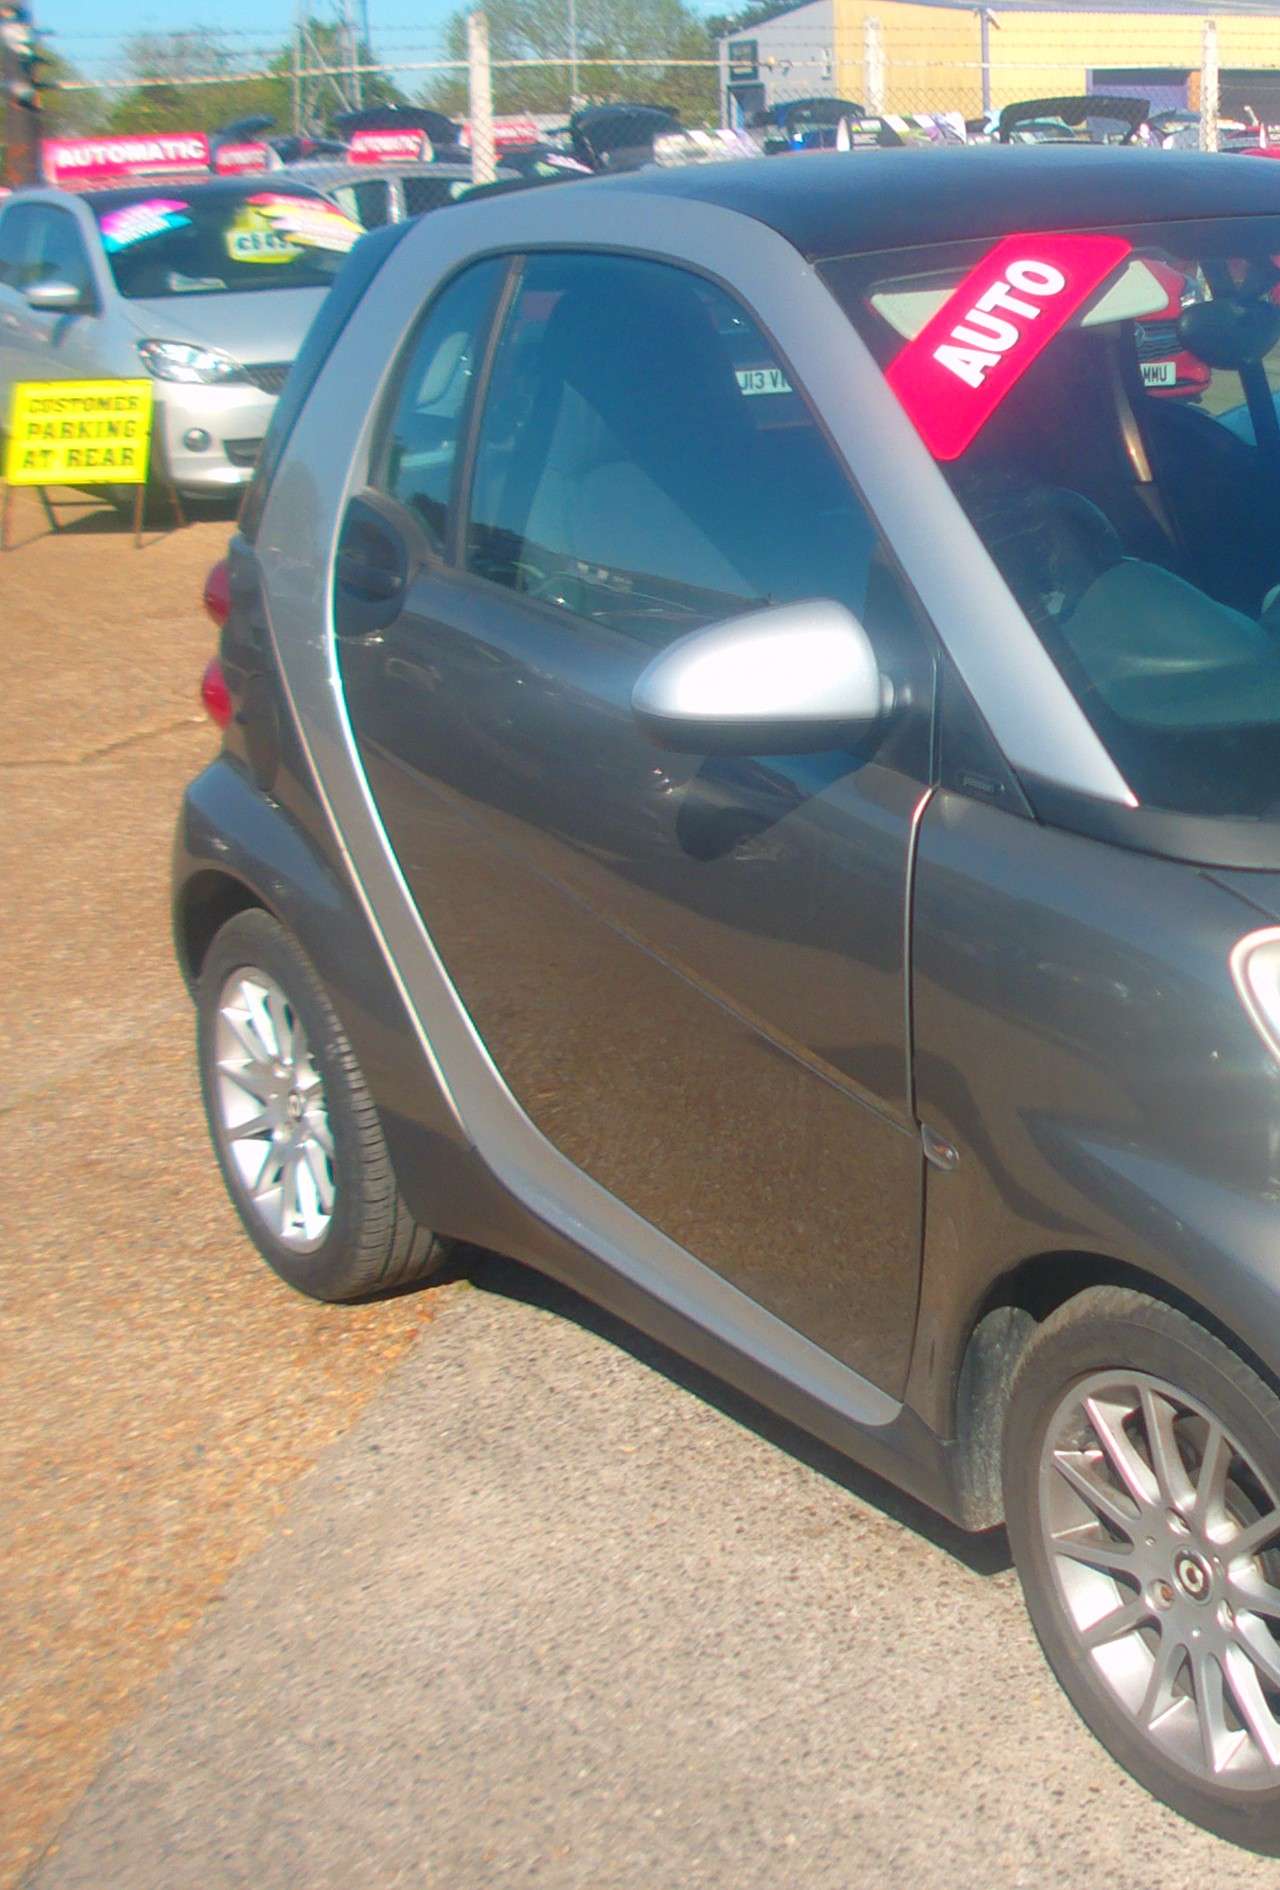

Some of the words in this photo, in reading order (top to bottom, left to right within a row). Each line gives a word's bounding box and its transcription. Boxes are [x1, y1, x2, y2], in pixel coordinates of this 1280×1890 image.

[57, 139, 206, 167] AUTOMATIC
[932, 259, 1066, 390] AUTO
[28, 396, 139, 413] CUSTOMER
[27, 419, 137, 439] PARKING
[23, 449, 54, 468] AT
[66, 447, 134, 467] REAR
